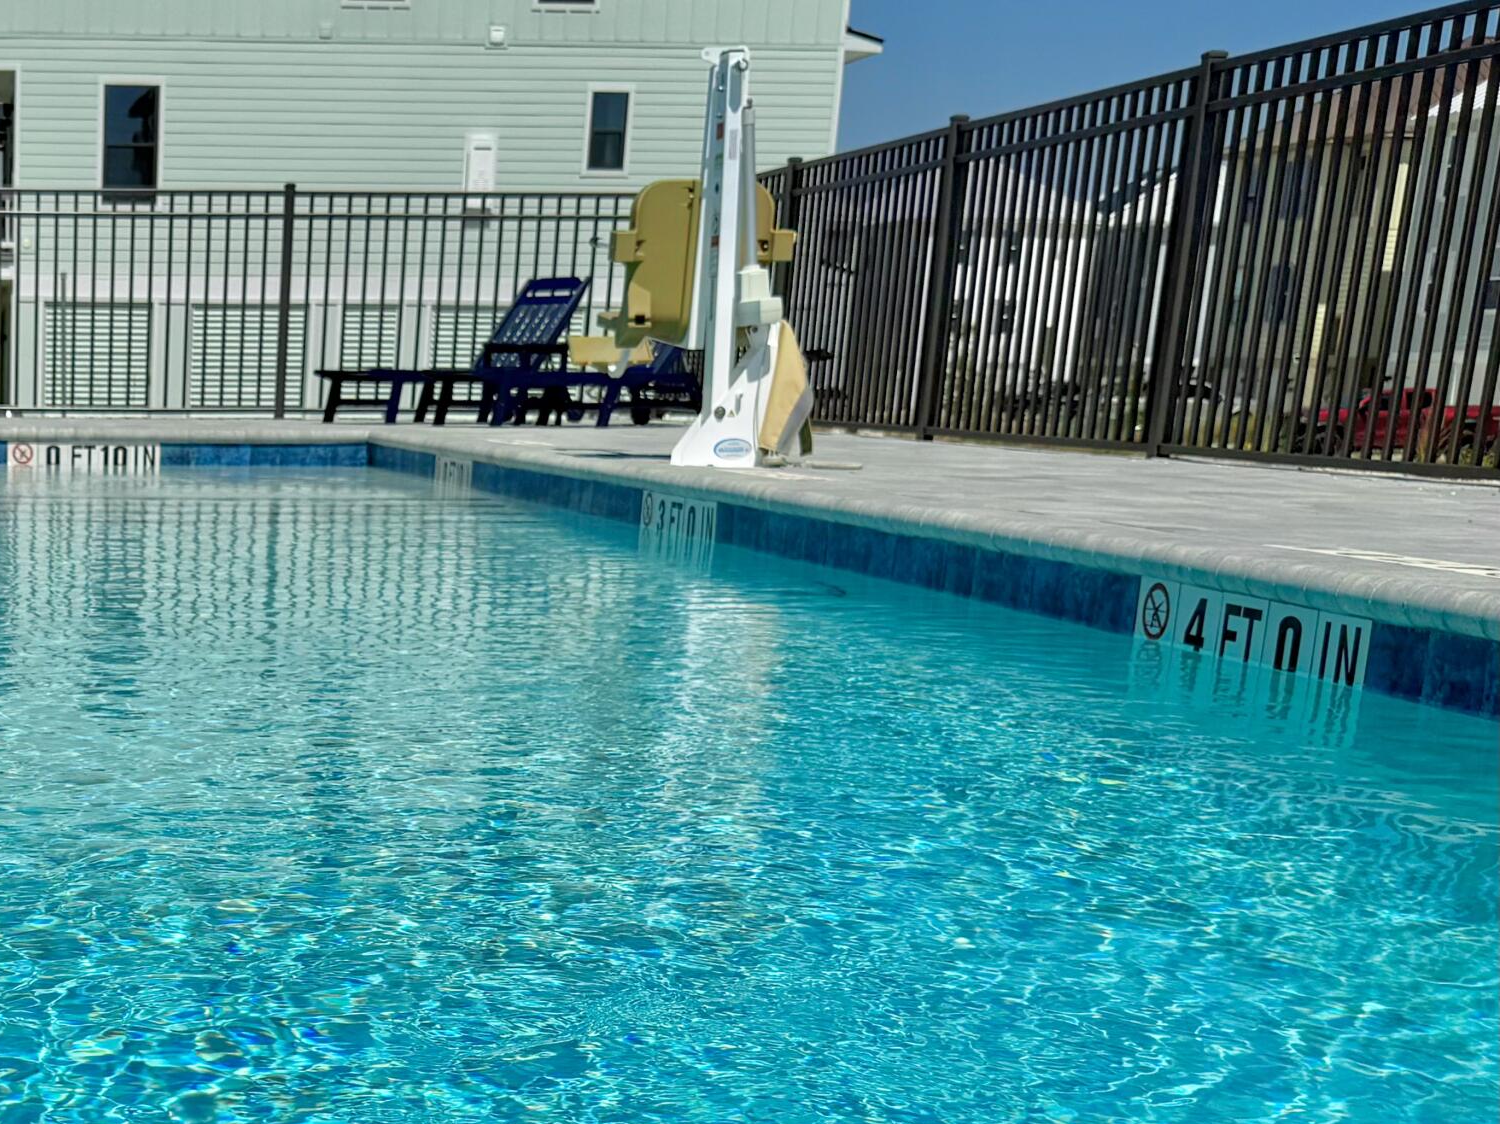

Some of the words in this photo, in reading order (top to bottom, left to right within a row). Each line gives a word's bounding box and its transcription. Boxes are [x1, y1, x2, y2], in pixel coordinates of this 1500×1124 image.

[71, 445, 96, 467] FT
[134, 446, 156, 468] IN
[656, 499, 666, 533] 3
[668, 502, 683, 536] FT
[687, 506, 696, 538] 0
[1183, 598, 1209, 653] 4
[1218, 603, 1264, 664] FT
[1273, 616, 1303, 674] 0
[1318, 621, 1363, 687] IN
